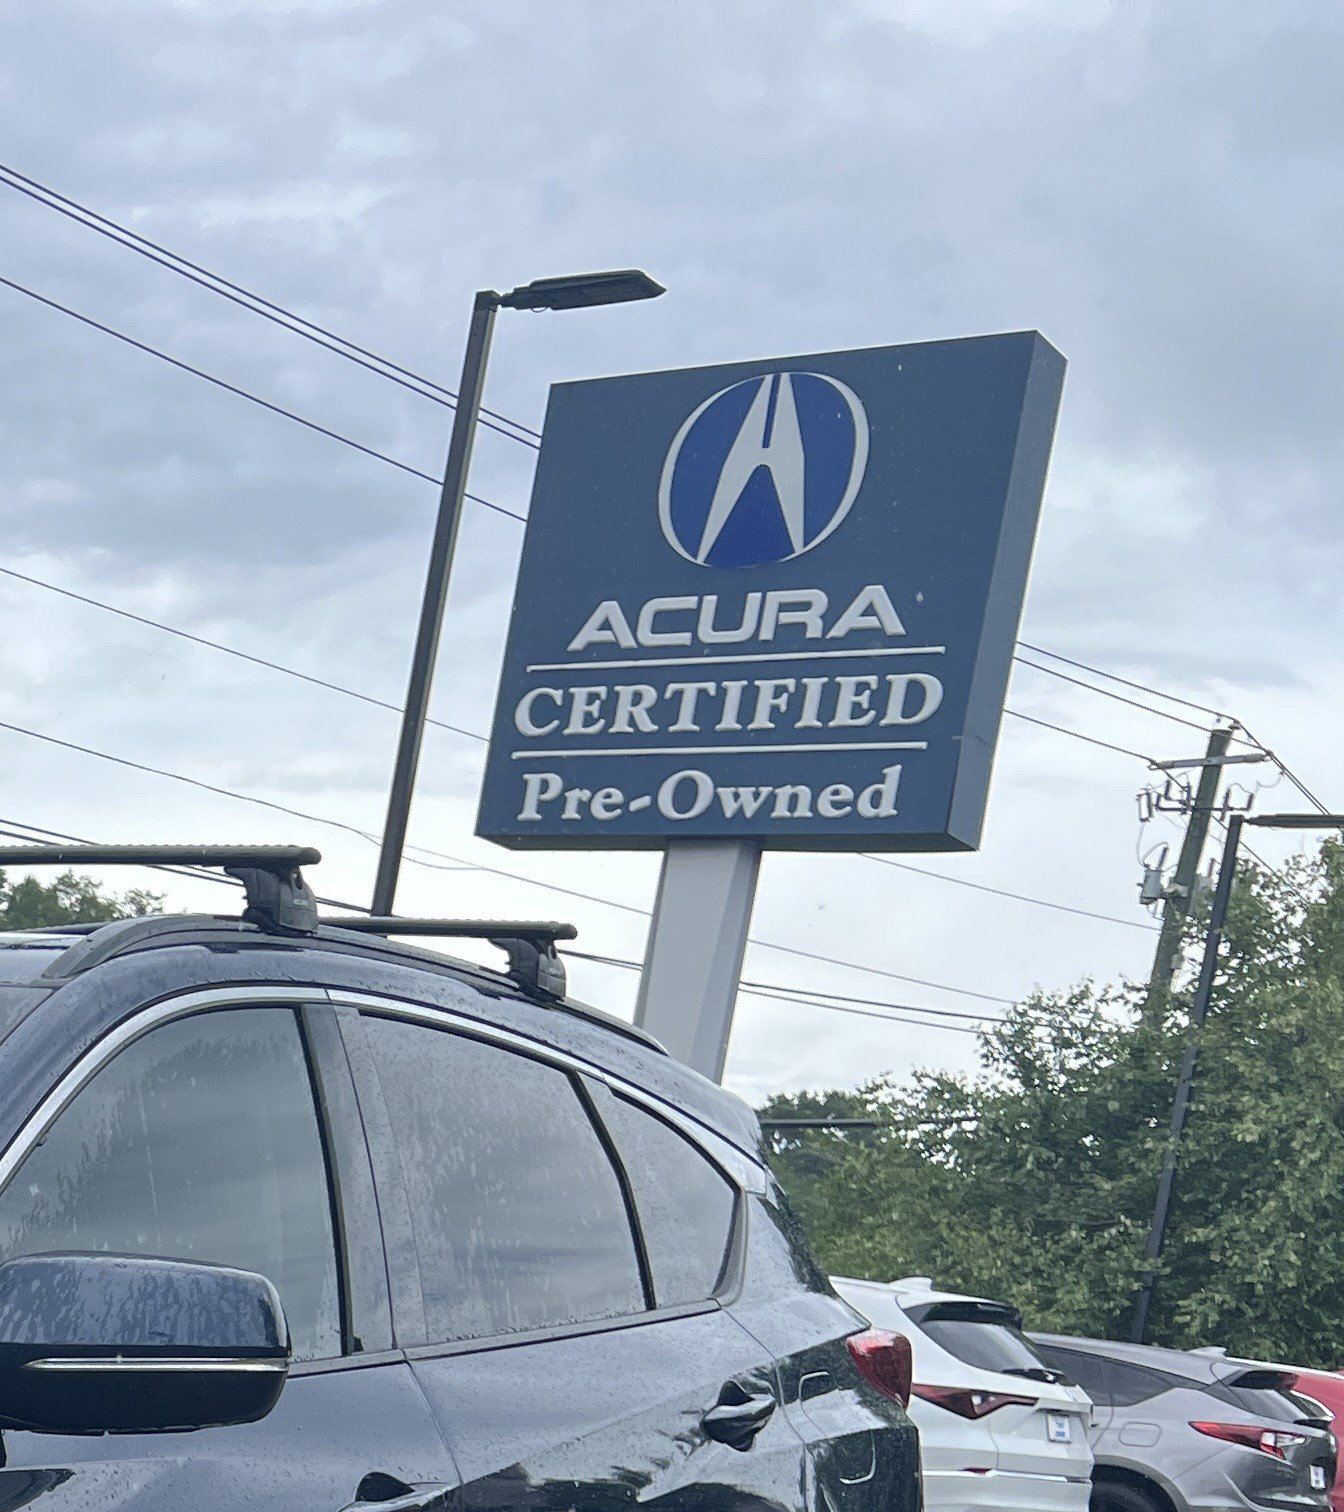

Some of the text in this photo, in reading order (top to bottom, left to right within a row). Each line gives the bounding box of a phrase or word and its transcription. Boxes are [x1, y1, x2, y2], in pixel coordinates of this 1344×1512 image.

[566, 584, 906, 652] ACURA
[513, 671, 944, 738] CERTIFIED
[515, 763, 902, 822] Pre-Owned
